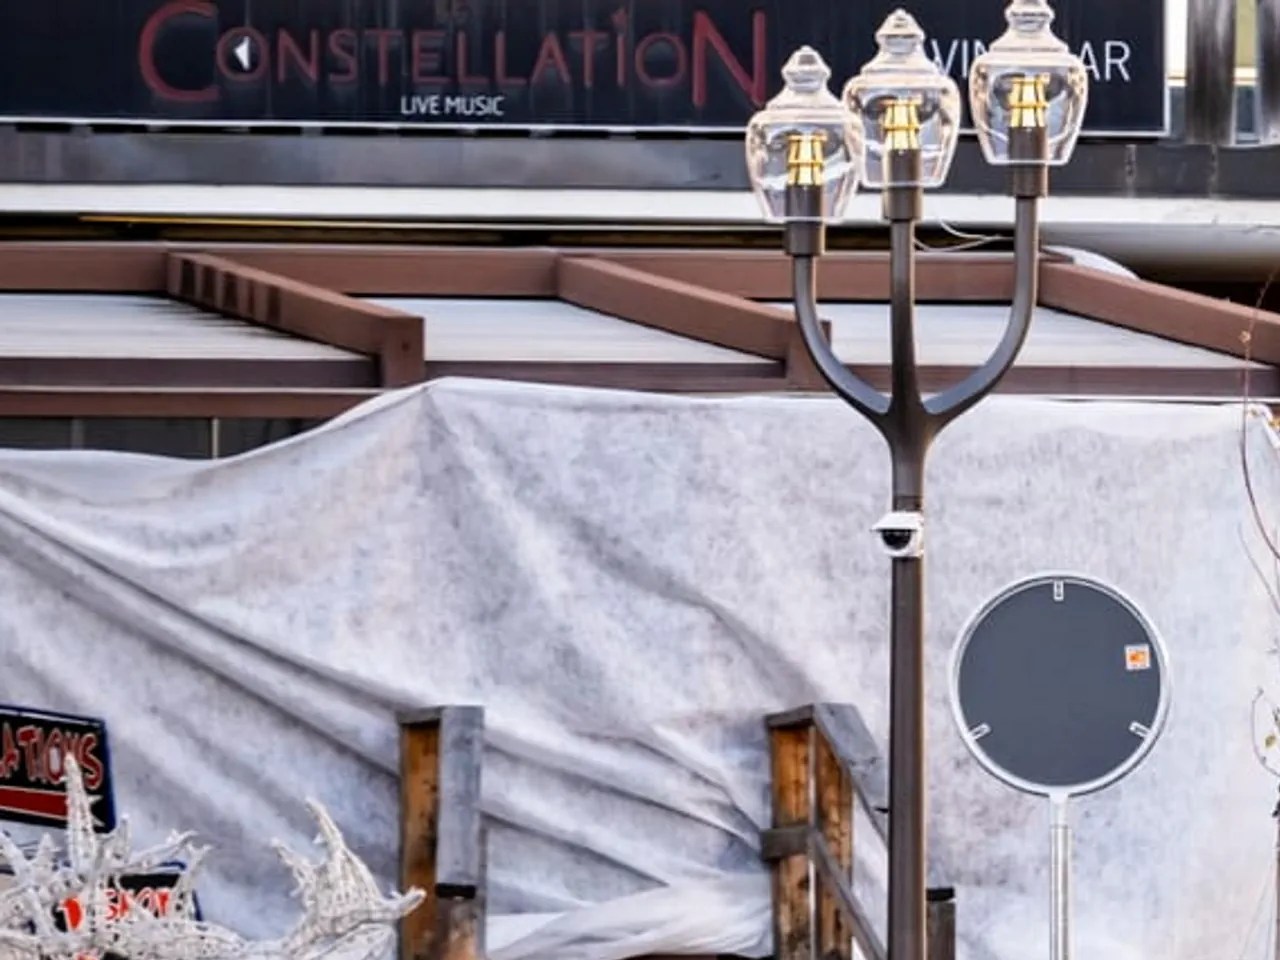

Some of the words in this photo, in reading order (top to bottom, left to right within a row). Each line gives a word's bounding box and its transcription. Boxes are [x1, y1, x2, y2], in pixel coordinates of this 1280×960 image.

[1077, 40, 1132, 81] AR
[401, 96, 439, 115] LIVE
[445, 96, 505, 116] MUSIC
